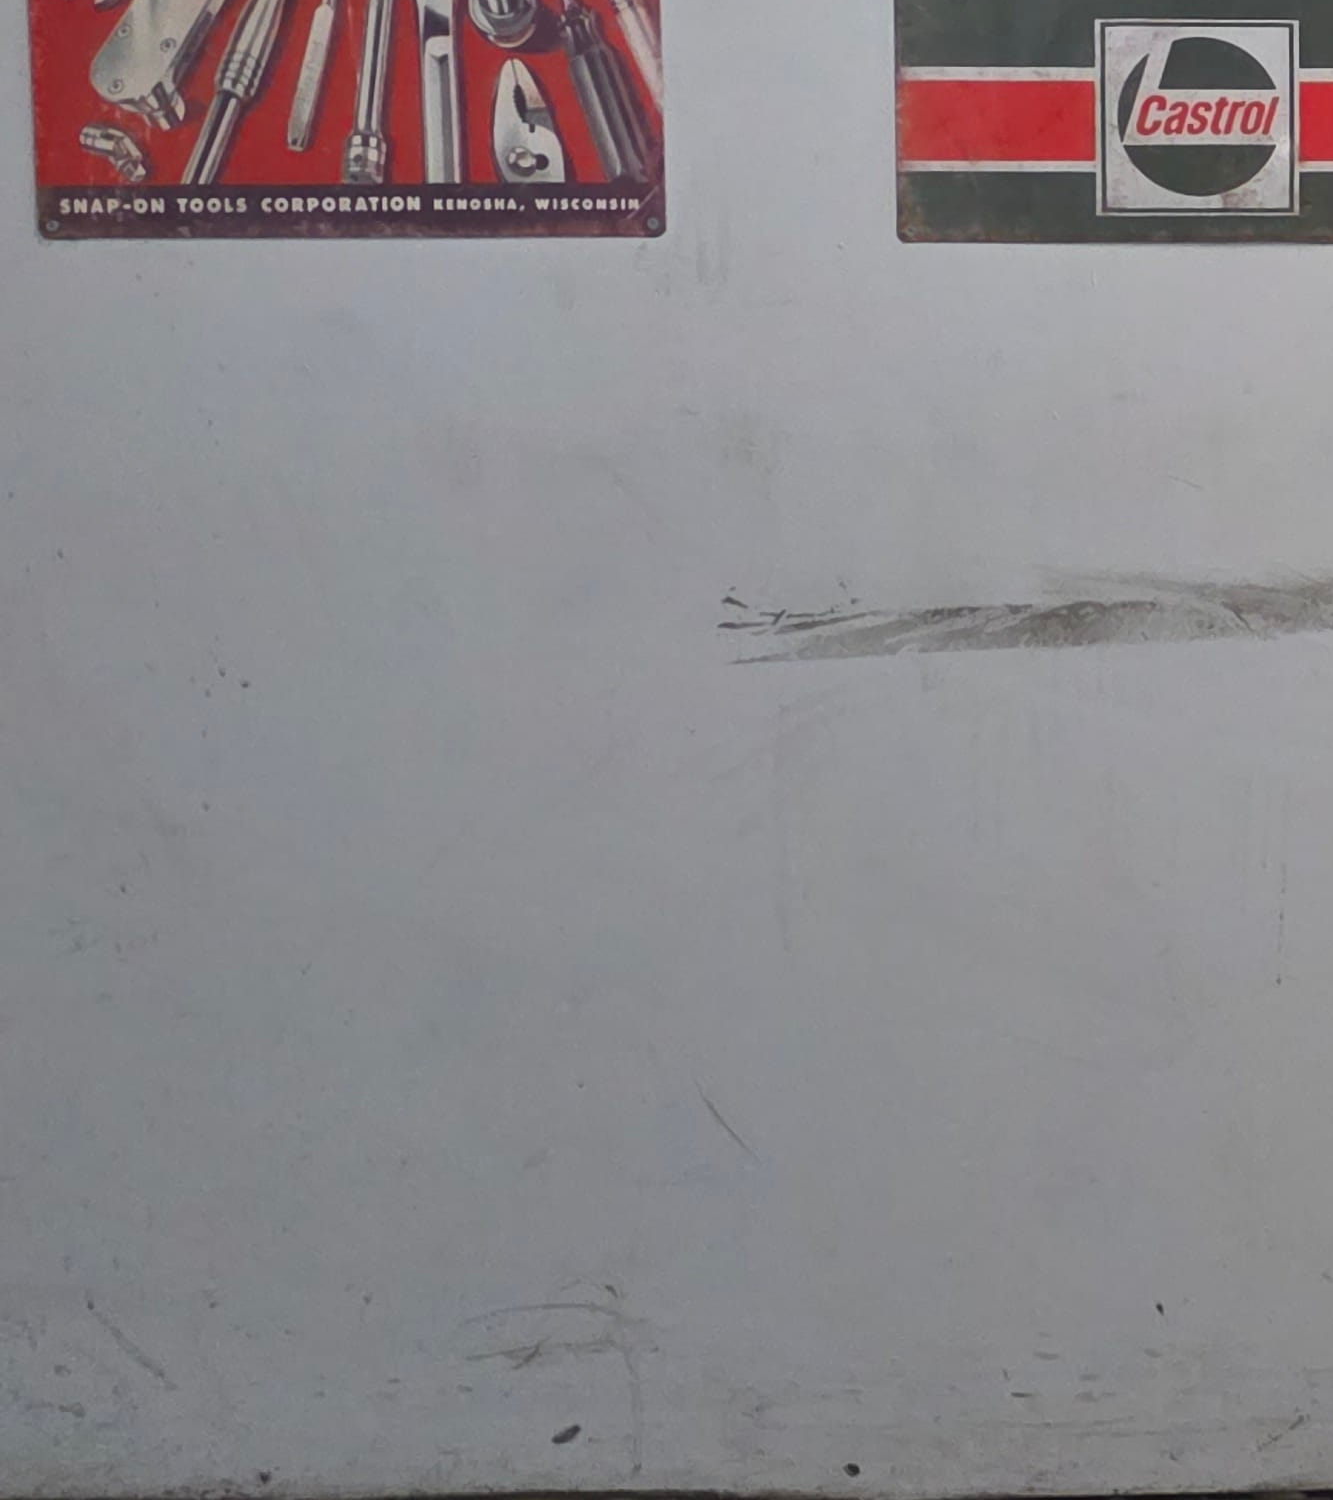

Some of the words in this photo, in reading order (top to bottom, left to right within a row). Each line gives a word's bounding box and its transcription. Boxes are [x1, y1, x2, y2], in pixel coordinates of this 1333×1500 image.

[1134, 92, 1279, 138] Castrol
[59, 198, 165, 214] SNAP-ON
[177, 197, 248, 214] TOOLS
[261, 196, 421, 213] CORPORATION
[433, 198, 526, 212] KENOSHA,
[535, 197, 640, 211] WISCONSIN
